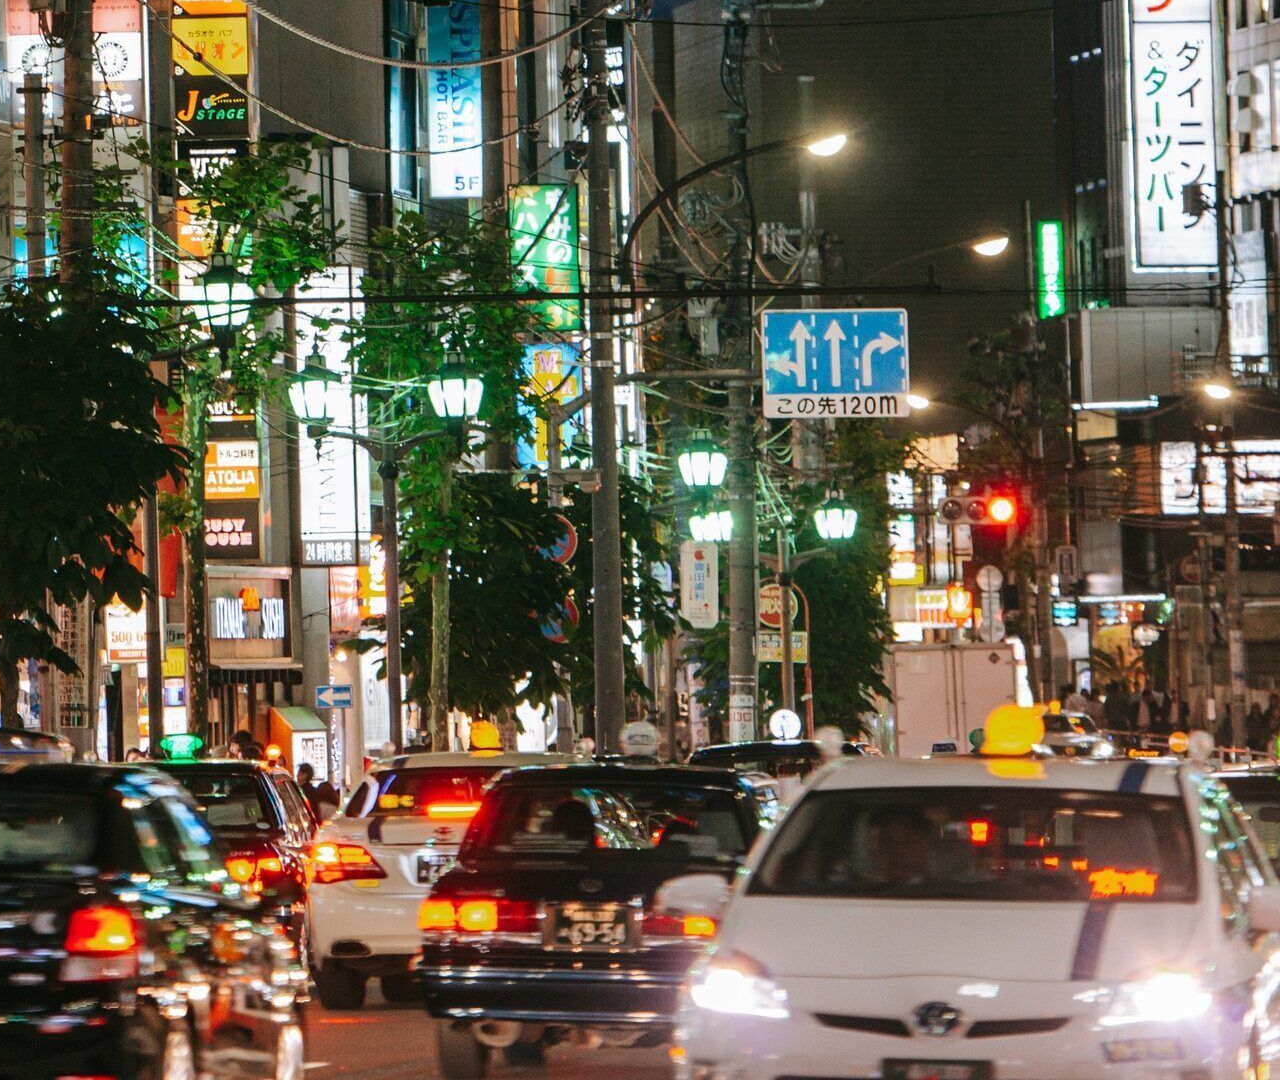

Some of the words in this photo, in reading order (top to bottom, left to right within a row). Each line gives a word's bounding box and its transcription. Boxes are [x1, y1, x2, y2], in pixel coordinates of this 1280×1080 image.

[188, 30, 215, 38] カラオケ
[196, 108, 245, 120] STAGE
[437, 110, 448, 145] BAR
[1177, 40, 1206, 231] ダイニン
[454, 176, 480, 192] 5F
[777, 395, 898, 416] この先120m
[207, 471, 256, 485] ATOLIA
[205, 533, 253, 546] OUSE
[305, 542, 353, 562] 24時間営業
